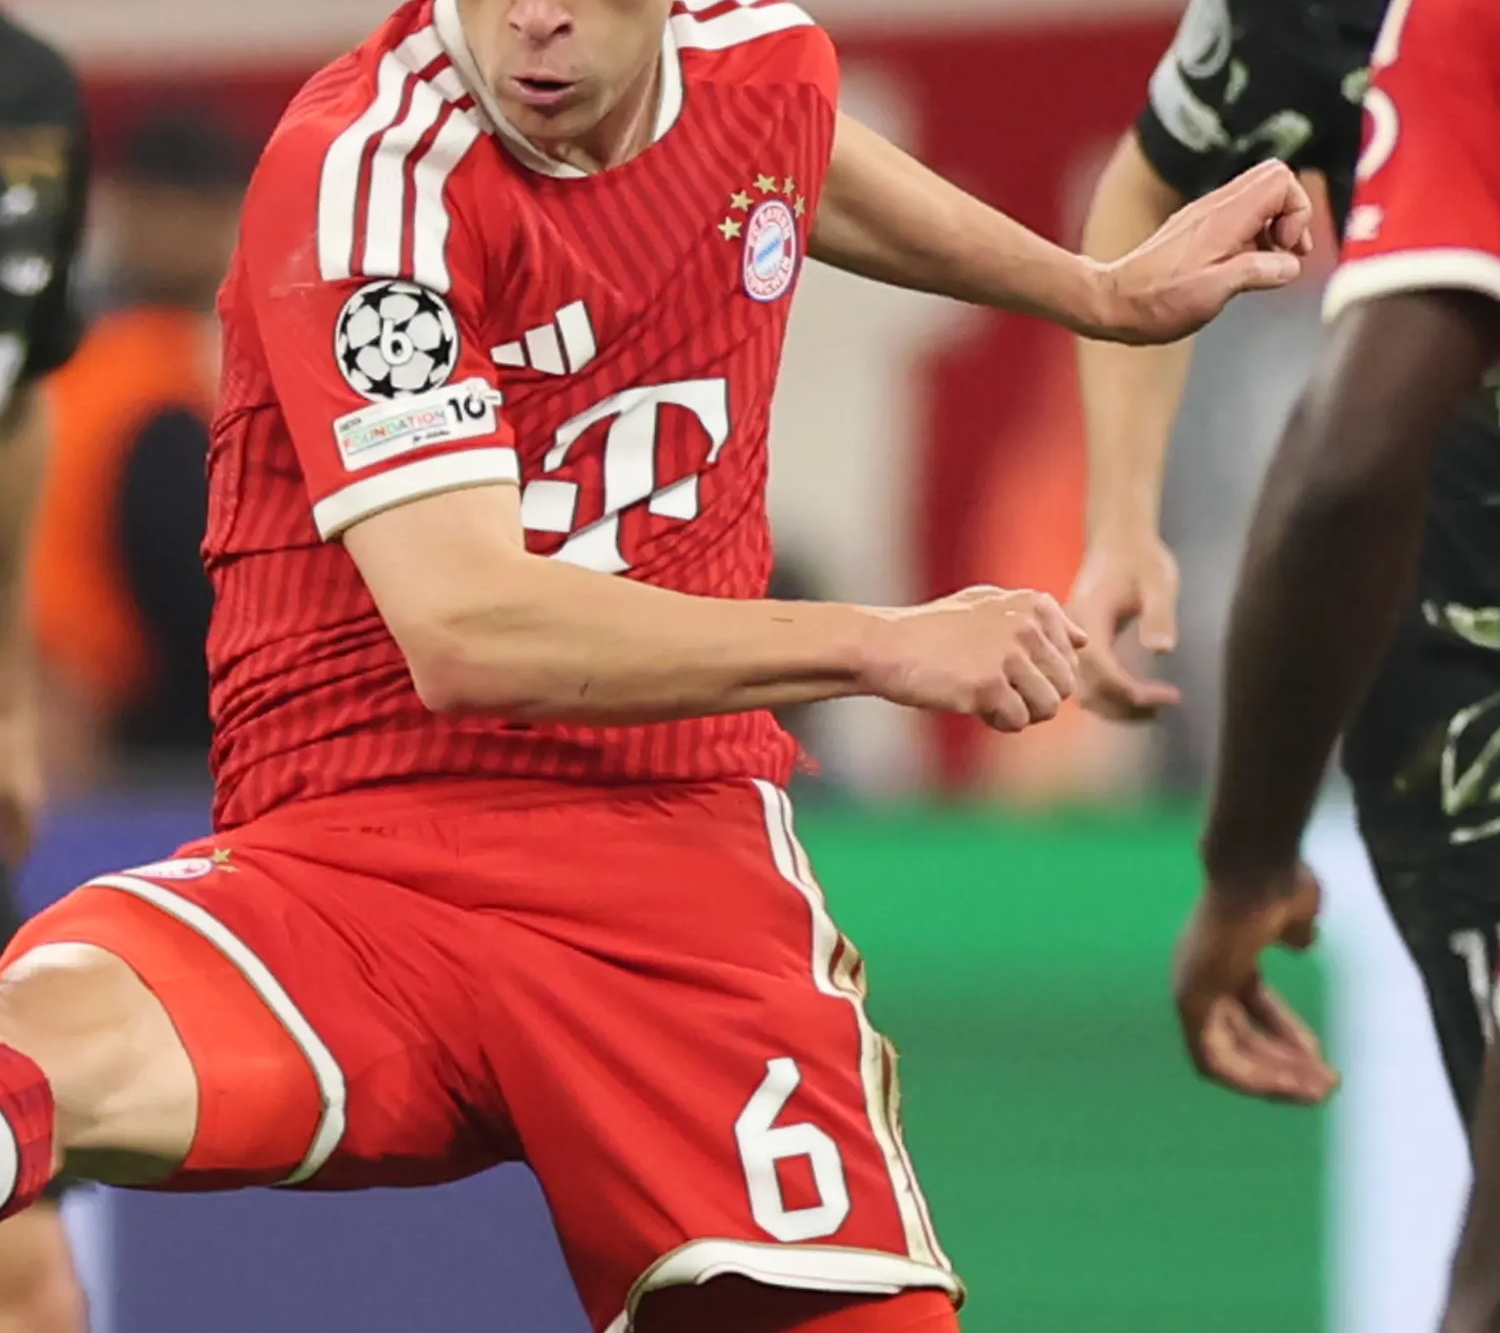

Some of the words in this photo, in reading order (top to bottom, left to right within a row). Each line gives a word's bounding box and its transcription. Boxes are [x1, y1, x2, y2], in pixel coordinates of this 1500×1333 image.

[380, 318, 414, 365] 6
[448, 394, 486, 423] 10
[734, 1056, 851, 1243] 6
